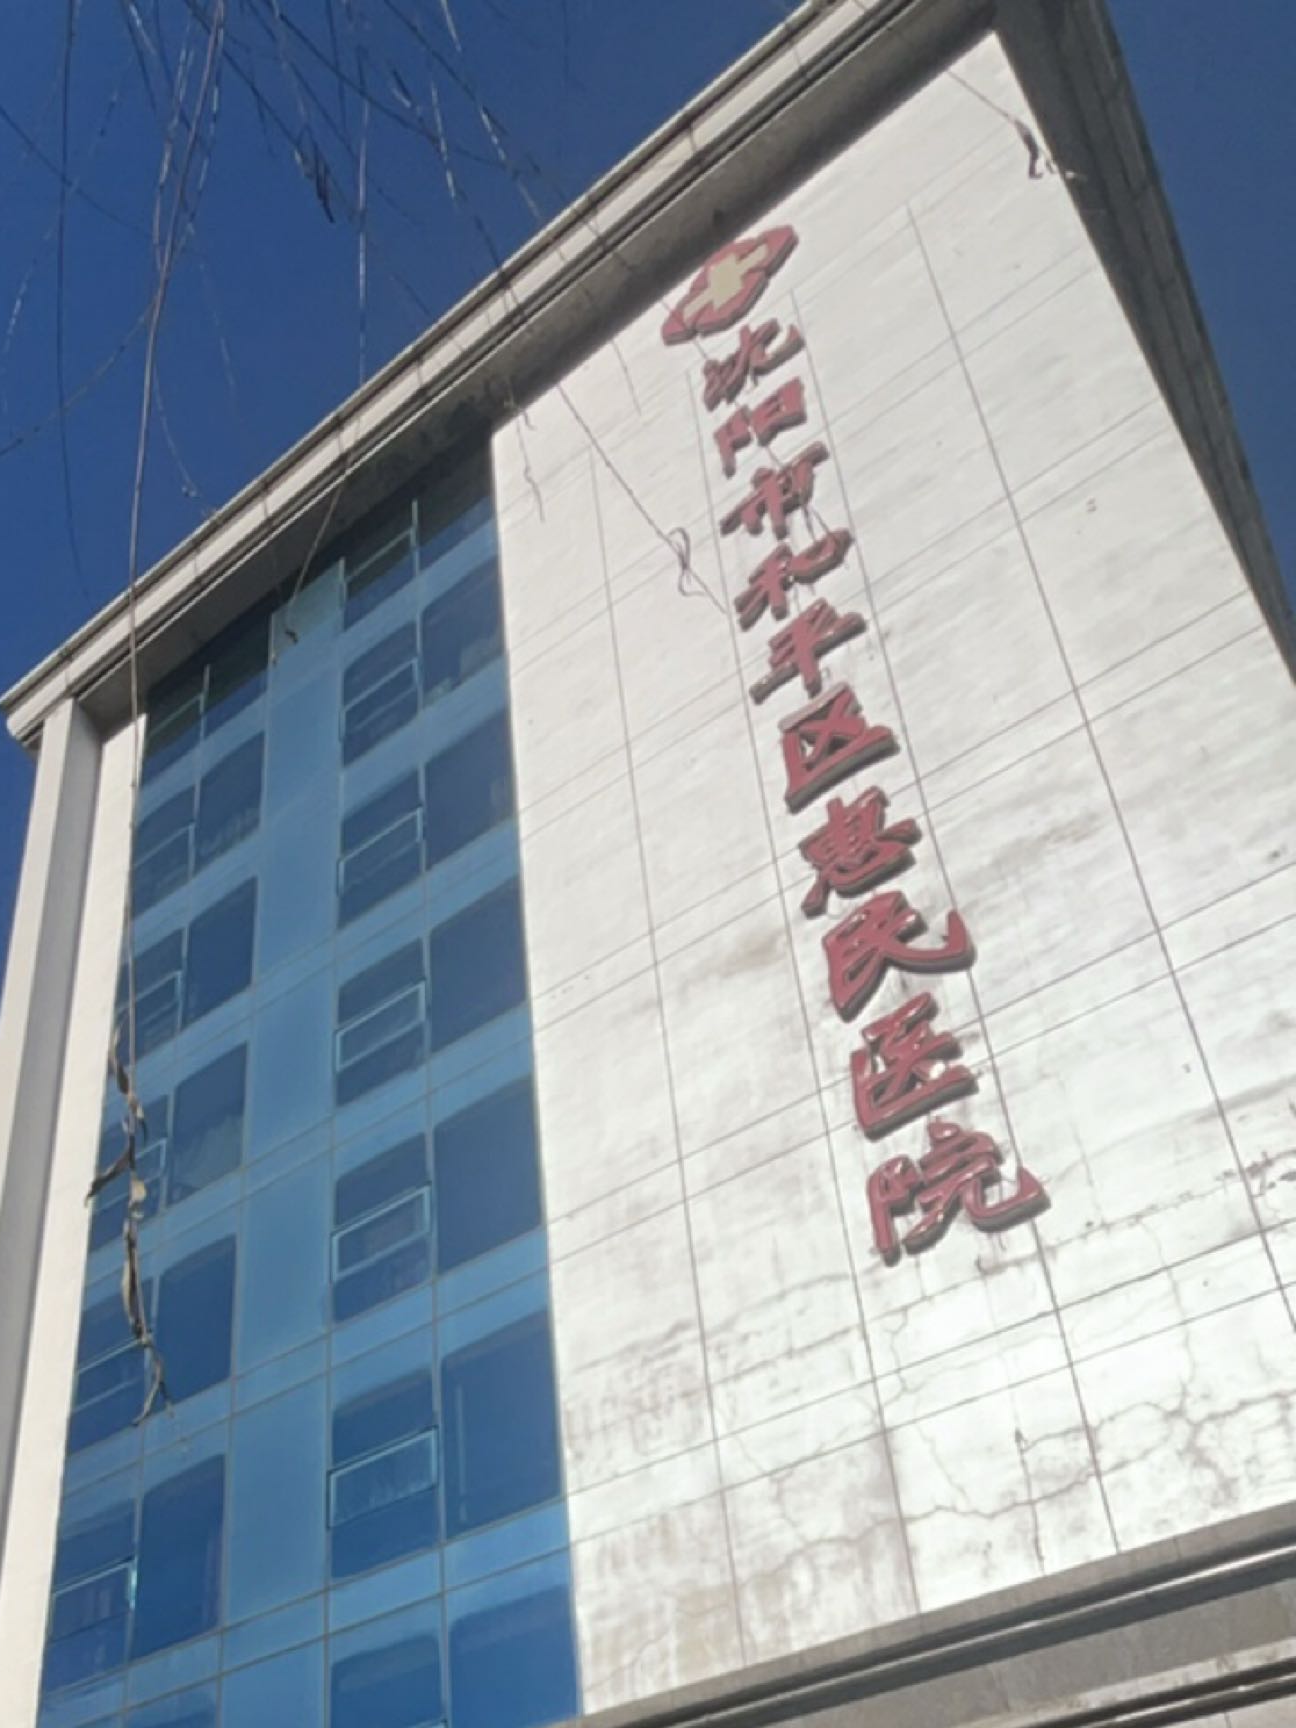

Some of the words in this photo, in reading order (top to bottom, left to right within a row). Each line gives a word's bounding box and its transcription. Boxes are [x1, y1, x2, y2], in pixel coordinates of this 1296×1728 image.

[703, 318, 1052, 1266] 沈阳市和平区惠民医院
